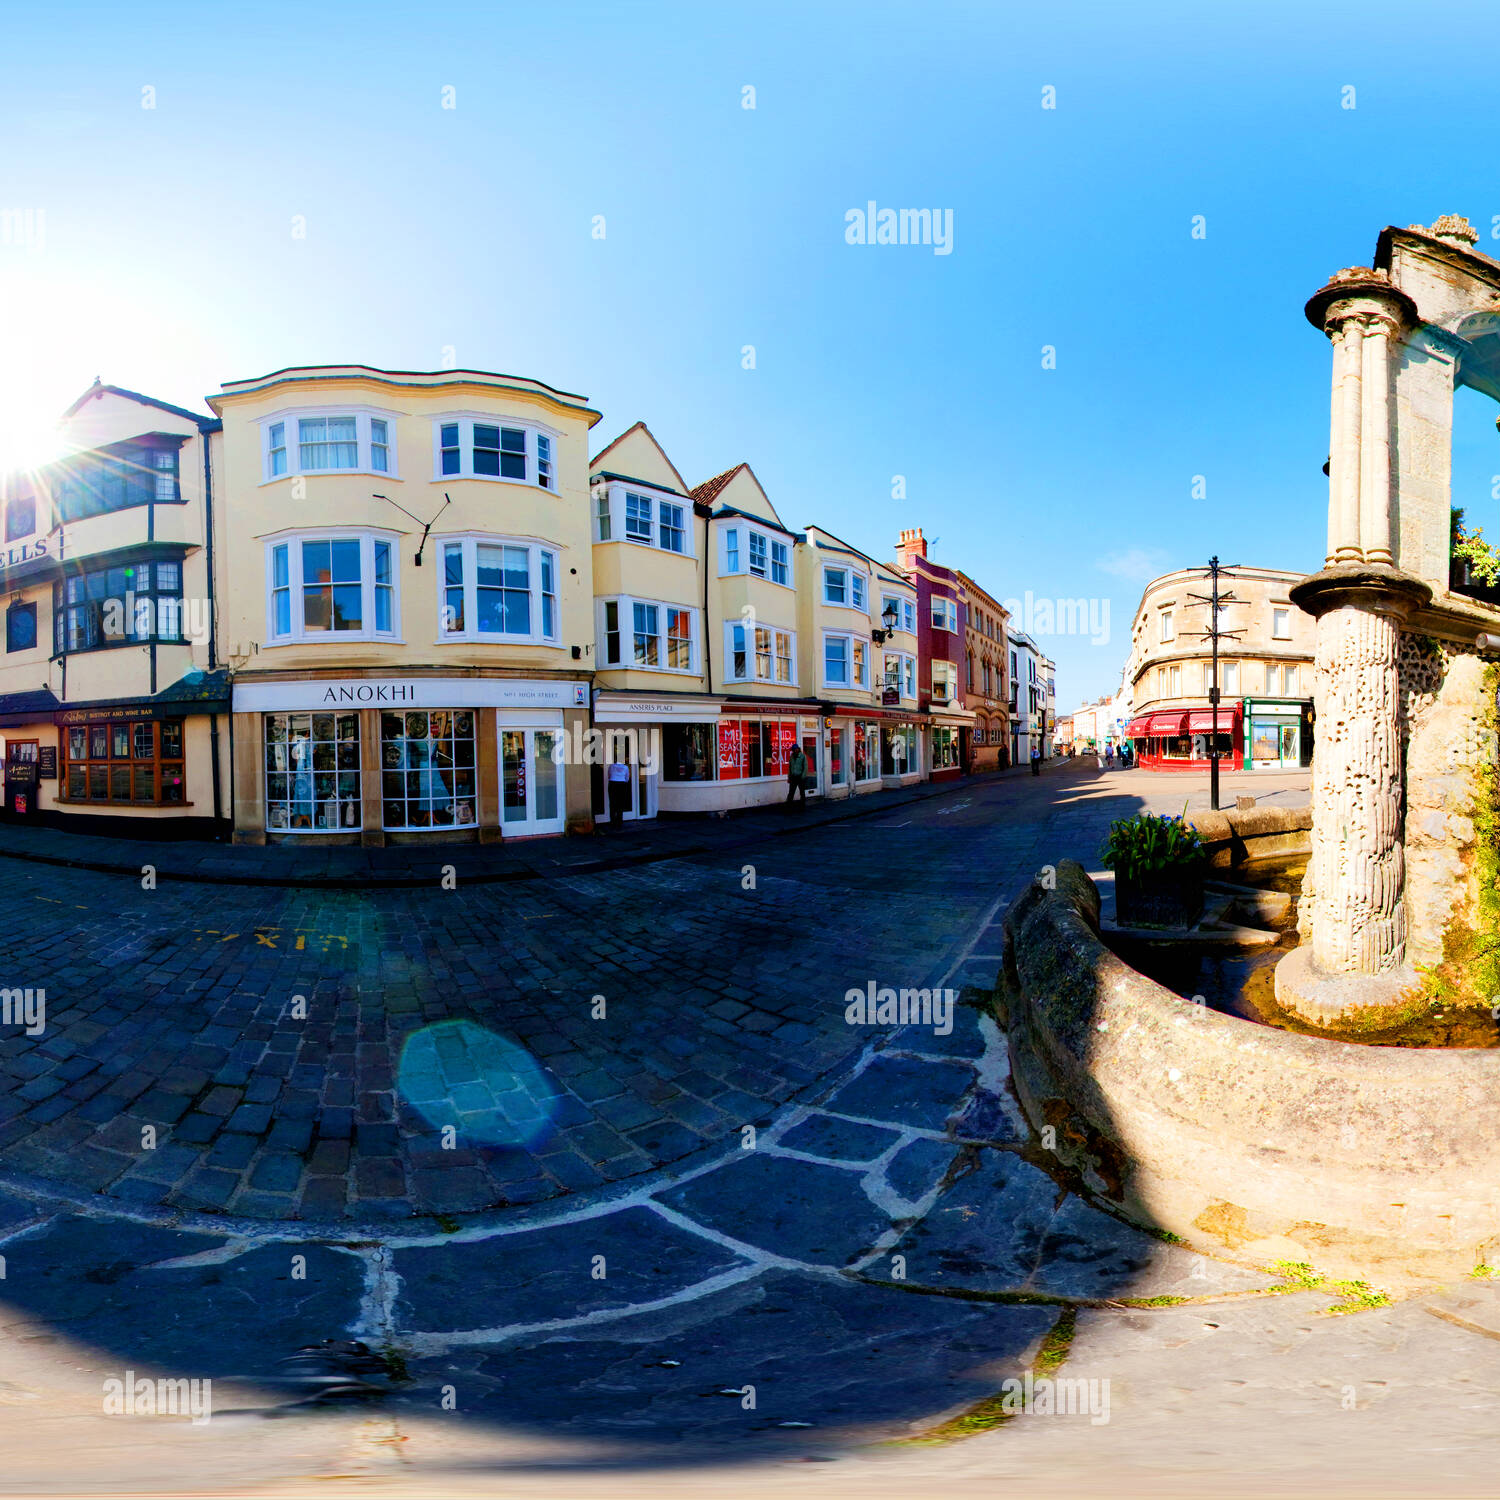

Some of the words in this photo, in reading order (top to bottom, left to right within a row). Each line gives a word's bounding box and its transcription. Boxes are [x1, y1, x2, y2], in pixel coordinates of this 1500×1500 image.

[323, 685, 414, 702] ANOKHI
[724, 729, 742, 741] MID
[719, 742, 749, 752] SEASON
[720, 752, 748, 768] SALE
